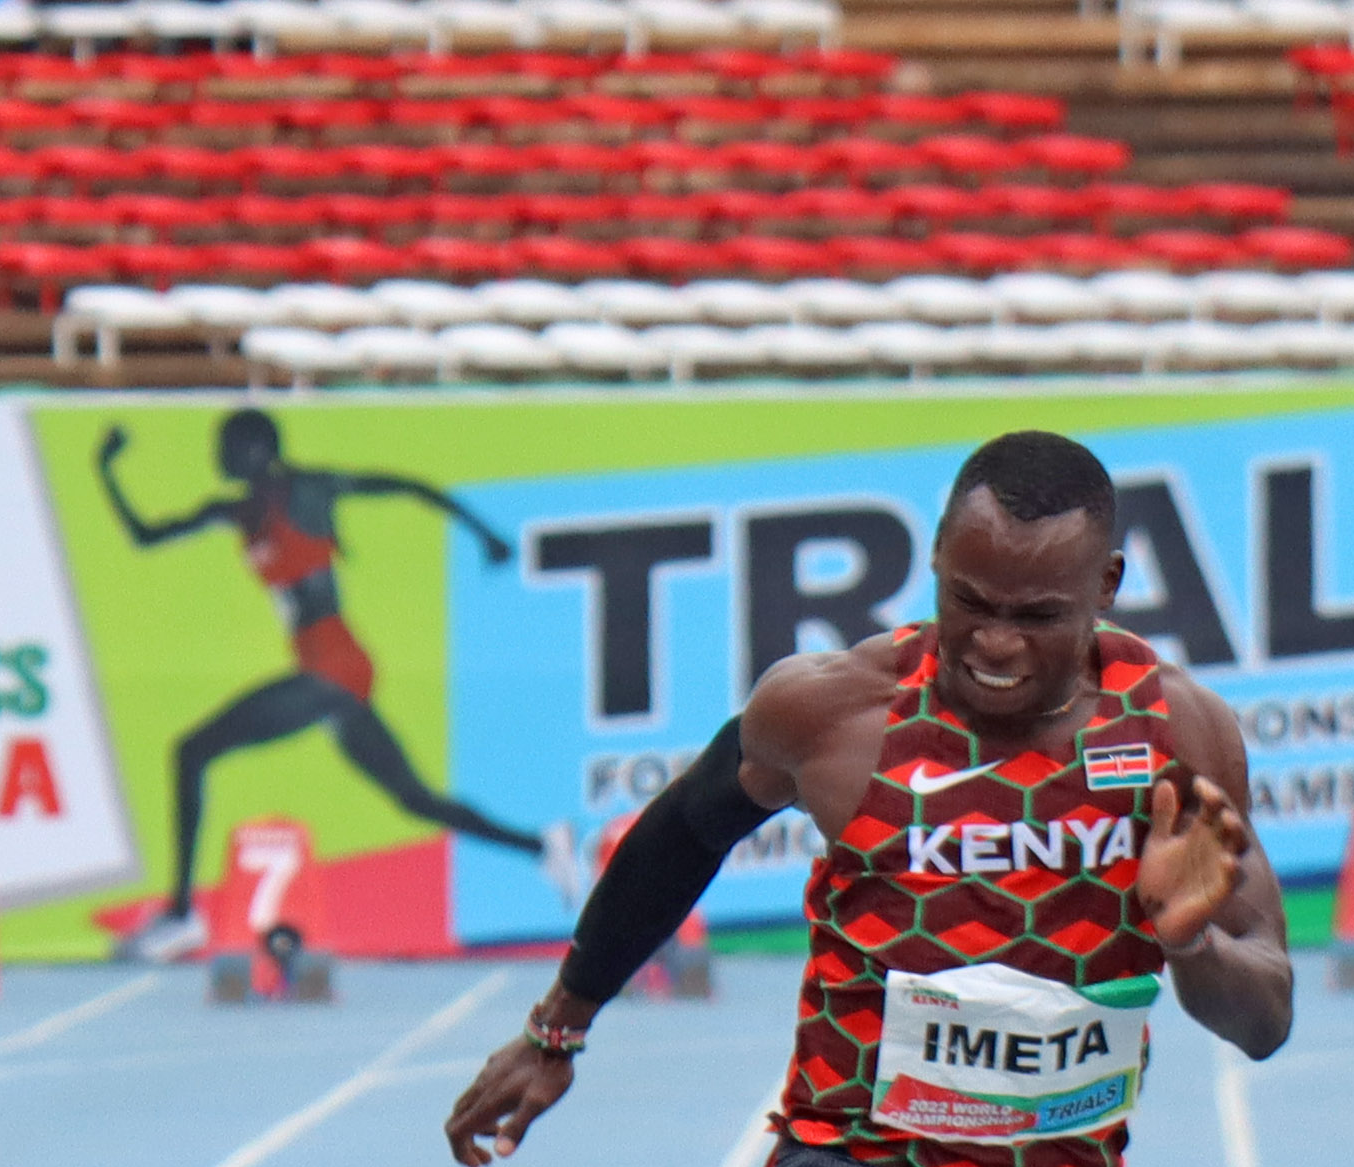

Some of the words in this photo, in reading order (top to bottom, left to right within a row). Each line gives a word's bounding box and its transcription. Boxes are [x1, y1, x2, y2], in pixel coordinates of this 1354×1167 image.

[909, 816, 1135, 874] KENYA
[238, 846, 302, 932] 7
[923, 1019, 1109, 1074] IMETA
[952, 1102, 1013, 1116] WORLD
[1046, 1083, 1118, 1123] TRIALS
